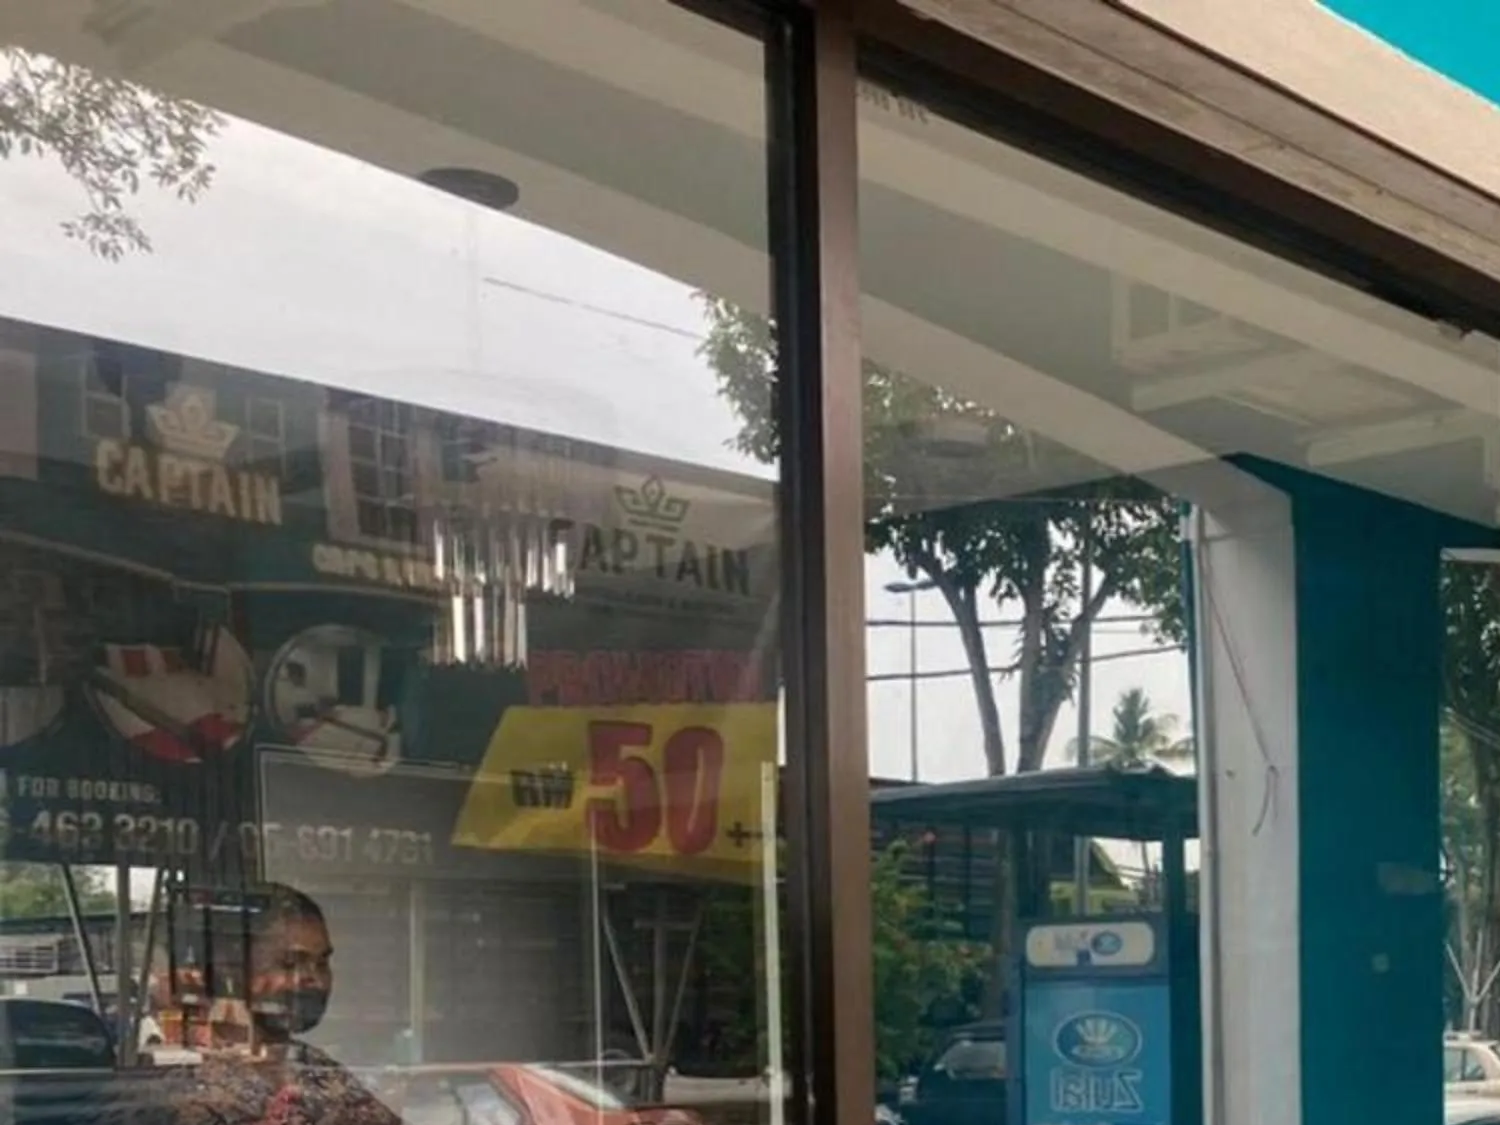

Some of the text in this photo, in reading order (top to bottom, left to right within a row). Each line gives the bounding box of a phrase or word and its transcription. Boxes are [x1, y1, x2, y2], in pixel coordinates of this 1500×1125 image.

[95, 438, 283, 526] CAPTAIN
[17, 776, 59, 799] FOR
[585, 720, 725, 854] 50
